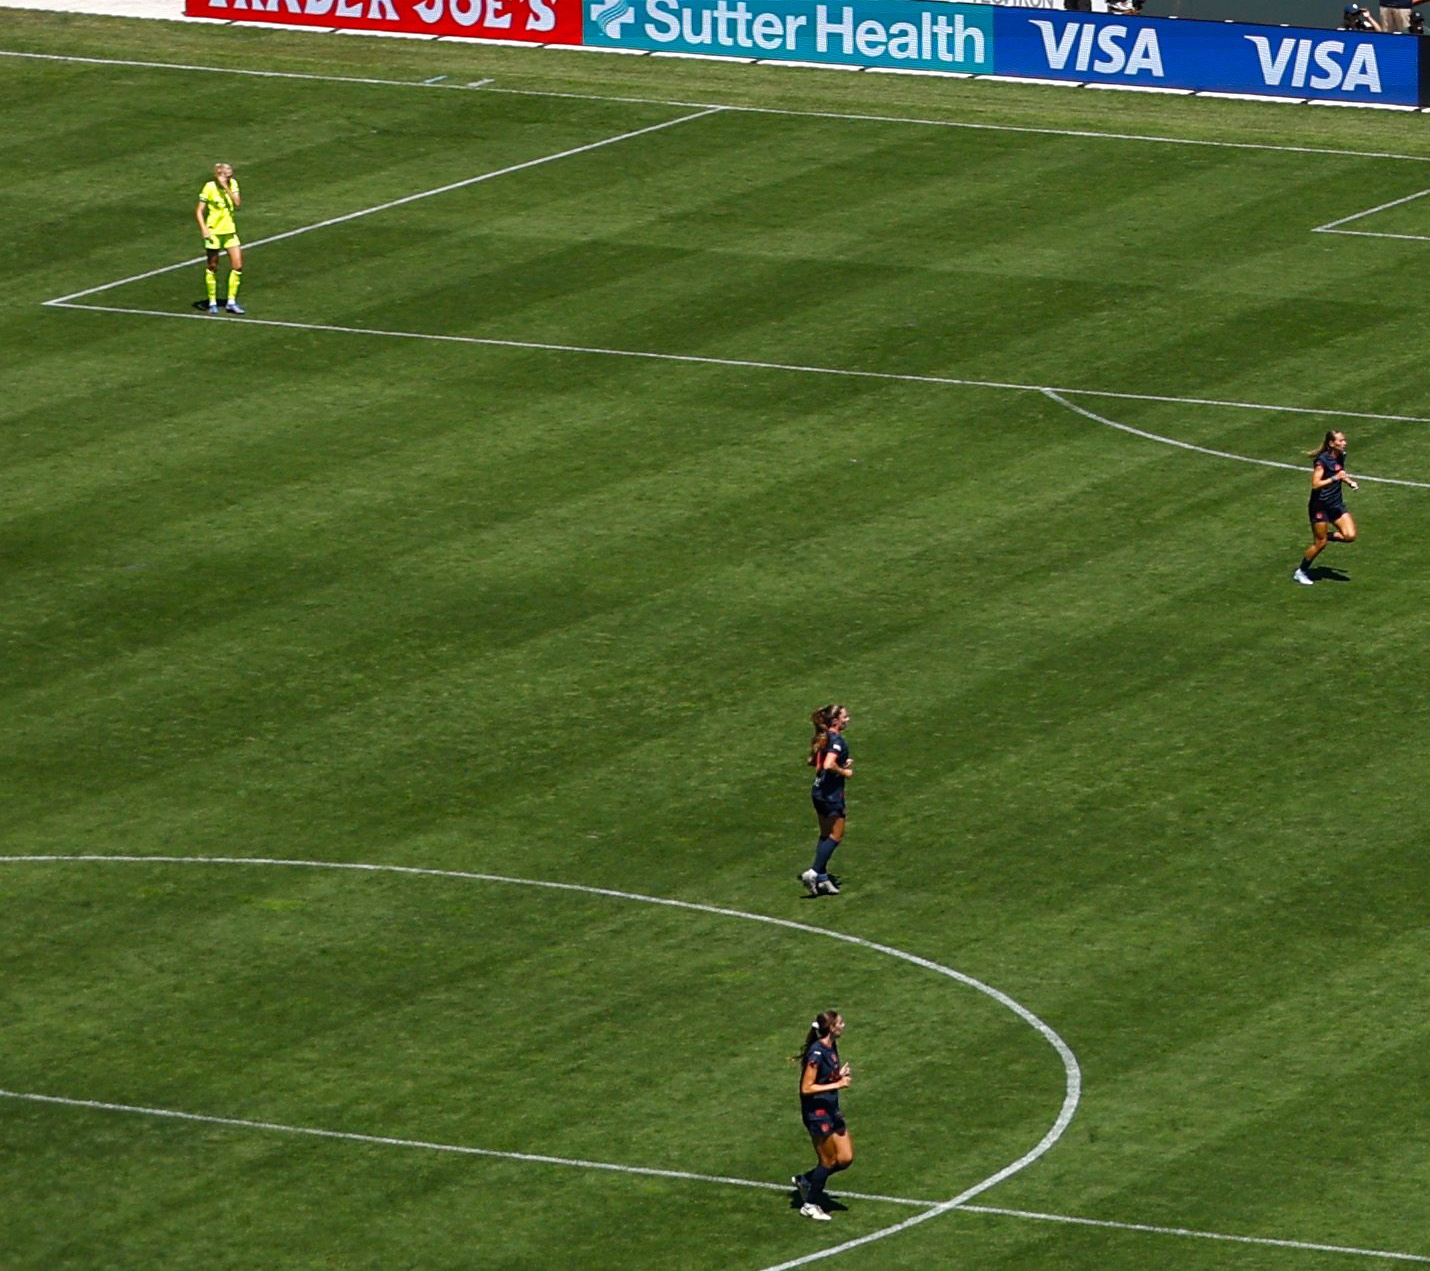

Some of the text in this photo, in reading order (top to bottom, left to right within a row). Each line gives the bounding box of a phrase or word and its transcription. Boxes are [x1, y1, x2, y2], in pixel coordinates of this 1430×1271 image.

[814, 6, 987, 66] Health
[1028, 17, 1165, 79] VISA
[1243, 34, 1383, 94] VISA
